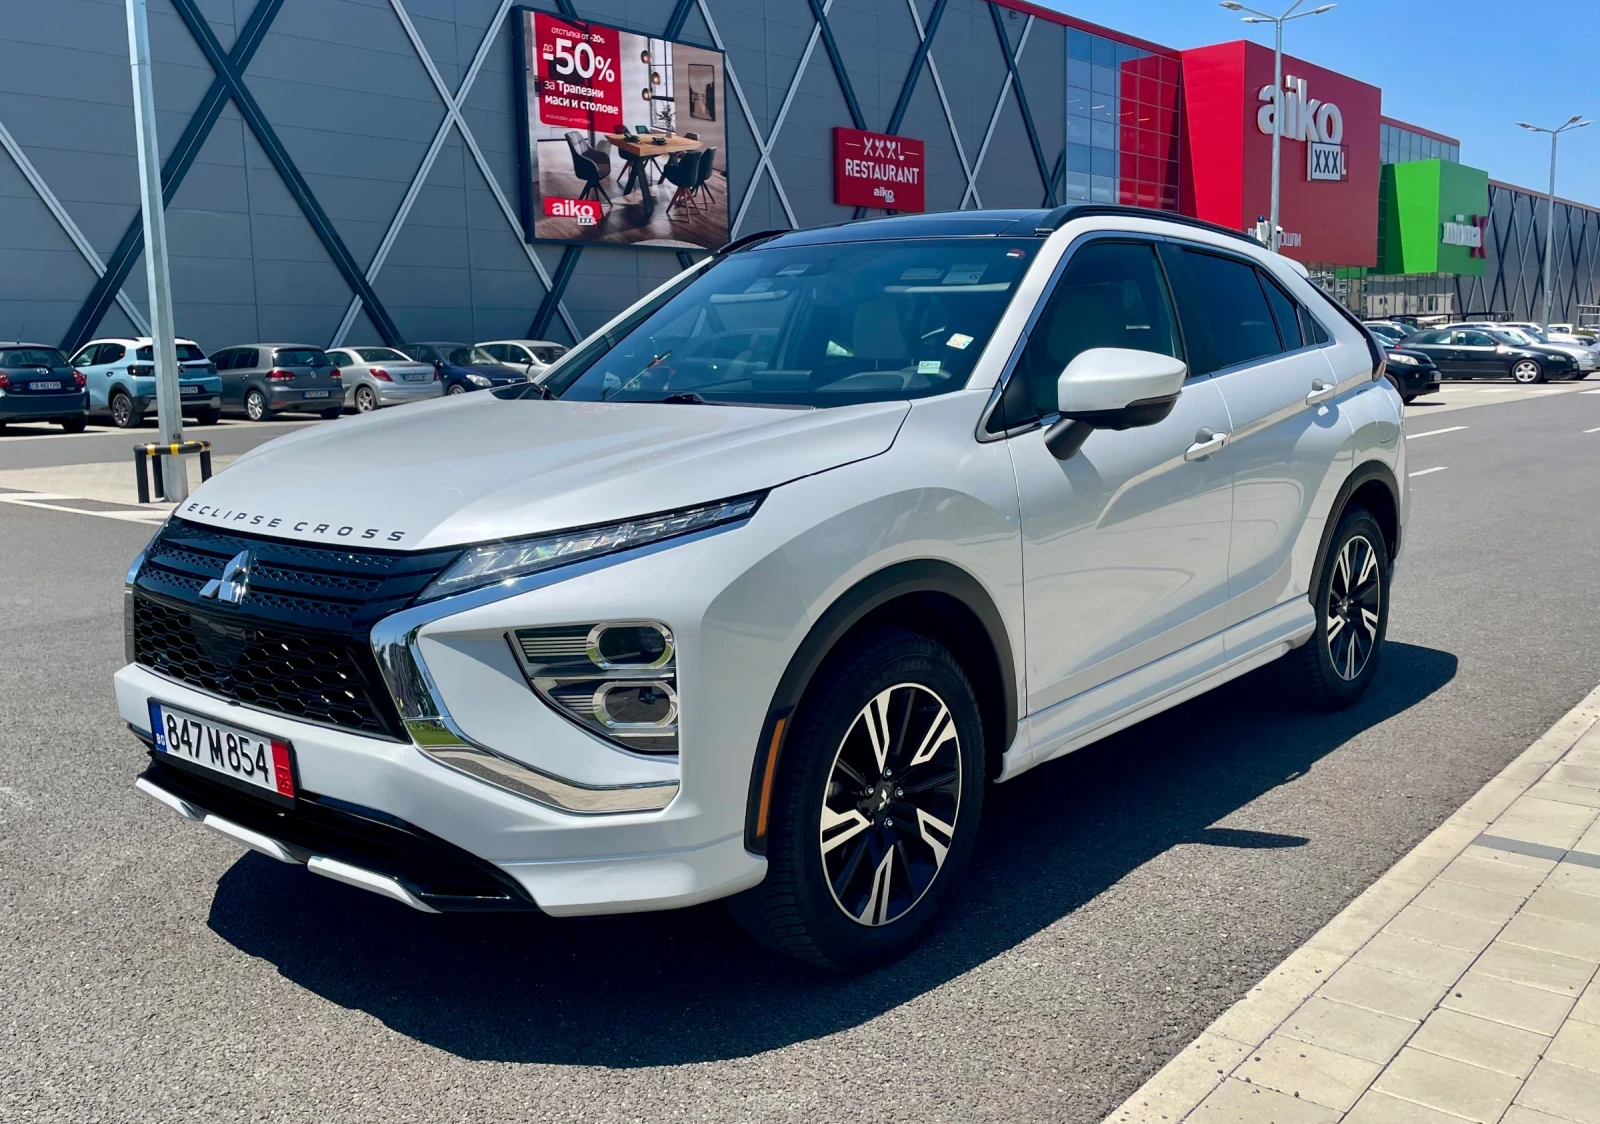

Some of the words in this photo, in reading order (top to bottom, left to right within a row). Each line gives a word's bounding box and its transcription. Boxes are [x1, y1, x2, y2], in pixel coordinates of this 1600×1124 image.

[543, 38, 615, 82] -50%
[544, 80, 556, 90] за
[557, 80, 604, 98] Трапезни
[545, 95, 570, 107] маси
[571, 99, 579, 108] и
[580, 101, 619, 114] столове
[1257, 75, 1343, 144] aiko
[845, 158, 919, 184] RESTAURANT
[1313, 149, 1347, 175] XXXL
[552, 199, 594, 217] aiko
[1278, 231, 1302, 248] ошли
[187, 503, 282, 528] ECLIPSE
[293, 521, 405, 542] CROSS
[155, 733, 166, 746] BG
[166, 713, 203, 759] 847
[207, 725, 225, 768] M
[226, 732, 270, 783] 854
